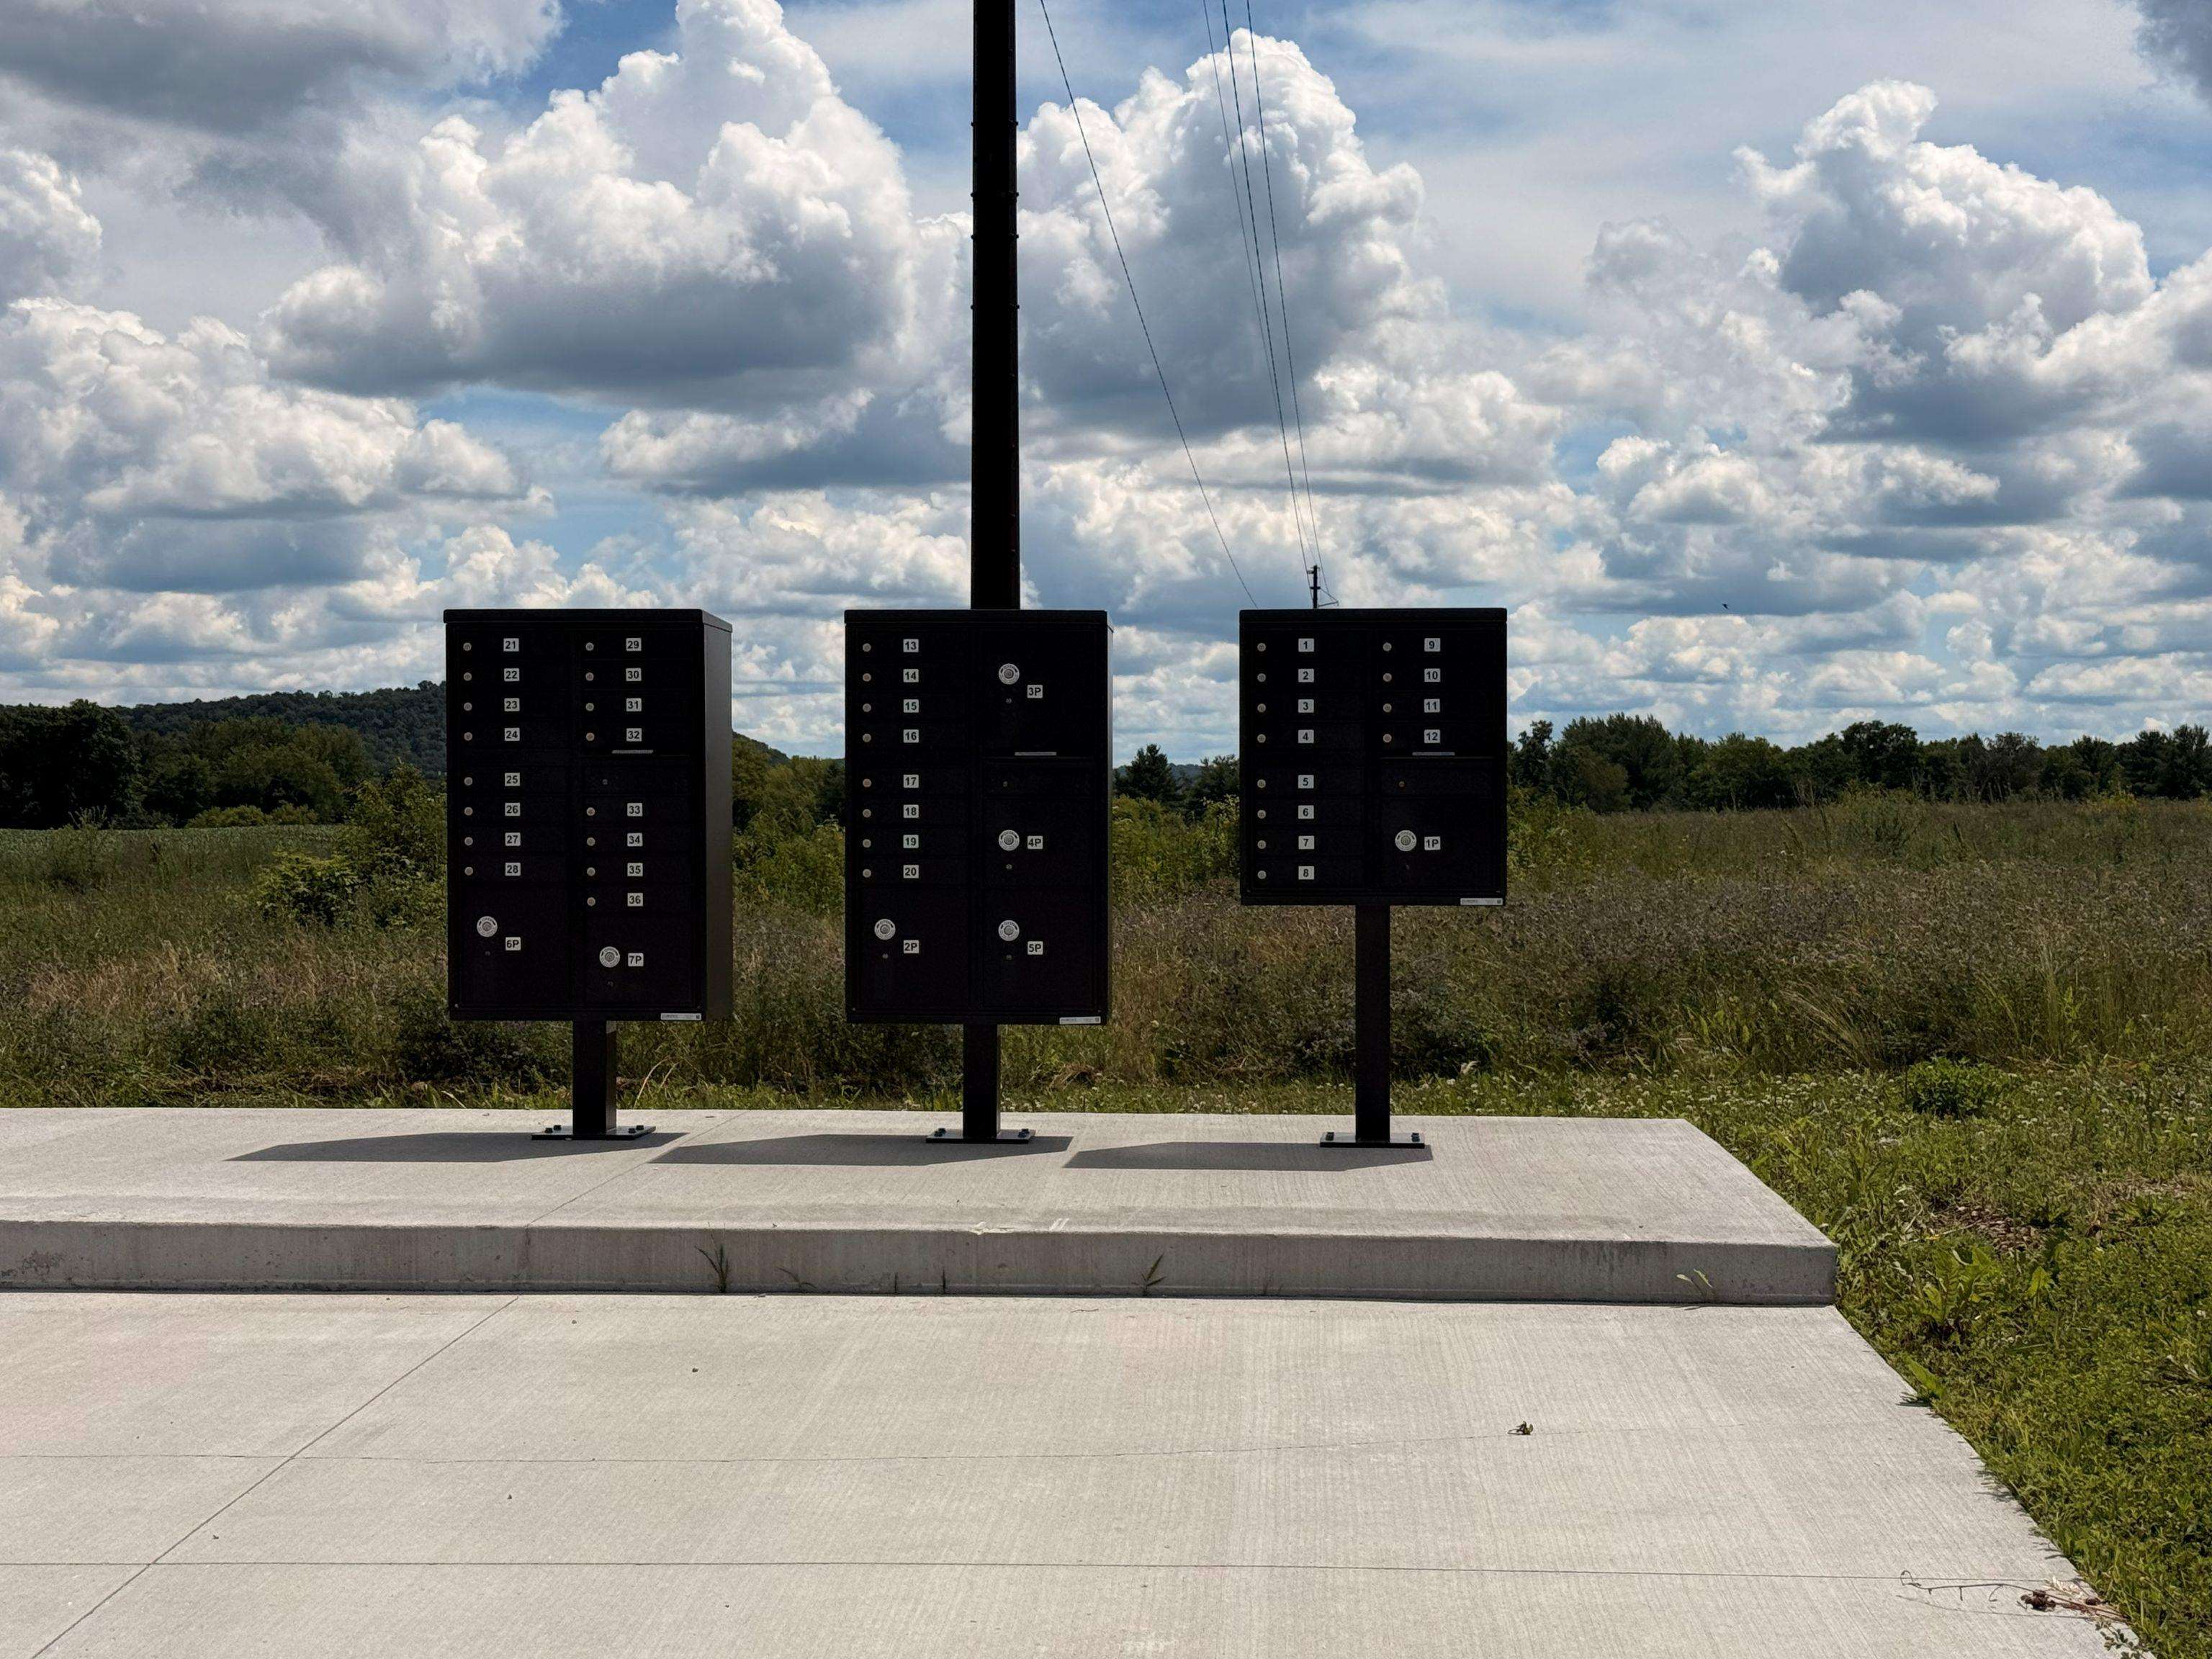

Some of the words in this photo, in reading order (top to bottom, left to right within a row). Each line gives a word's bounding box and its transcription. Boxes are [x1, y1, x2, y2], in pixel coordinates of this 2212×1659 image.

[505, 640, 516, 649] 21
[627, 640, 639, 649] 29
[904, 641, 917, 650] 13
[505, 670, 518, 680] 22
[627, 670, 639, 680] 30
[904, 671, 917, 680] 14
[1426, 670, 1439, 680] 10
[1028, 687, 1042, 696] 3P
[505, 700, 518, 709] 23
[627, 700, 639, 709] 31
[904, 701, 917, 711] 15
[1425, 701, 1437, 711] 11
[505, 730, 518, 739] 24
[627, 730, 640, 739] 32
[904, 732, 917, 741] 16
[1425, 732, 1438, 741] 12
[505, 775, 518, 784] 25
[904, 776, 917, 786] 17
[506, 805, 518, 814] 26
[629, 805, 641, 814] 33
[904, 806, 917, 816] 18
[506, 835, 518, 844] 27
[629, 835, 641, 845] 34
[904, 837, 917, 846] 19
[1028, 838, 1042, 847] 4P
[1426, 838, 1439, 848] 1P
[506, 865, 518, 874] 28
[629, 865, 642, 875] 35
[904, 867, 917, 876] 20
[629, 895, 642, 904] 36
[506, 940, 520, 948] 6P
[904, 942, 918, 951] 2P
[1028, 943, 1042, 953] 5P
[629, 955, 642, 964] 7P
